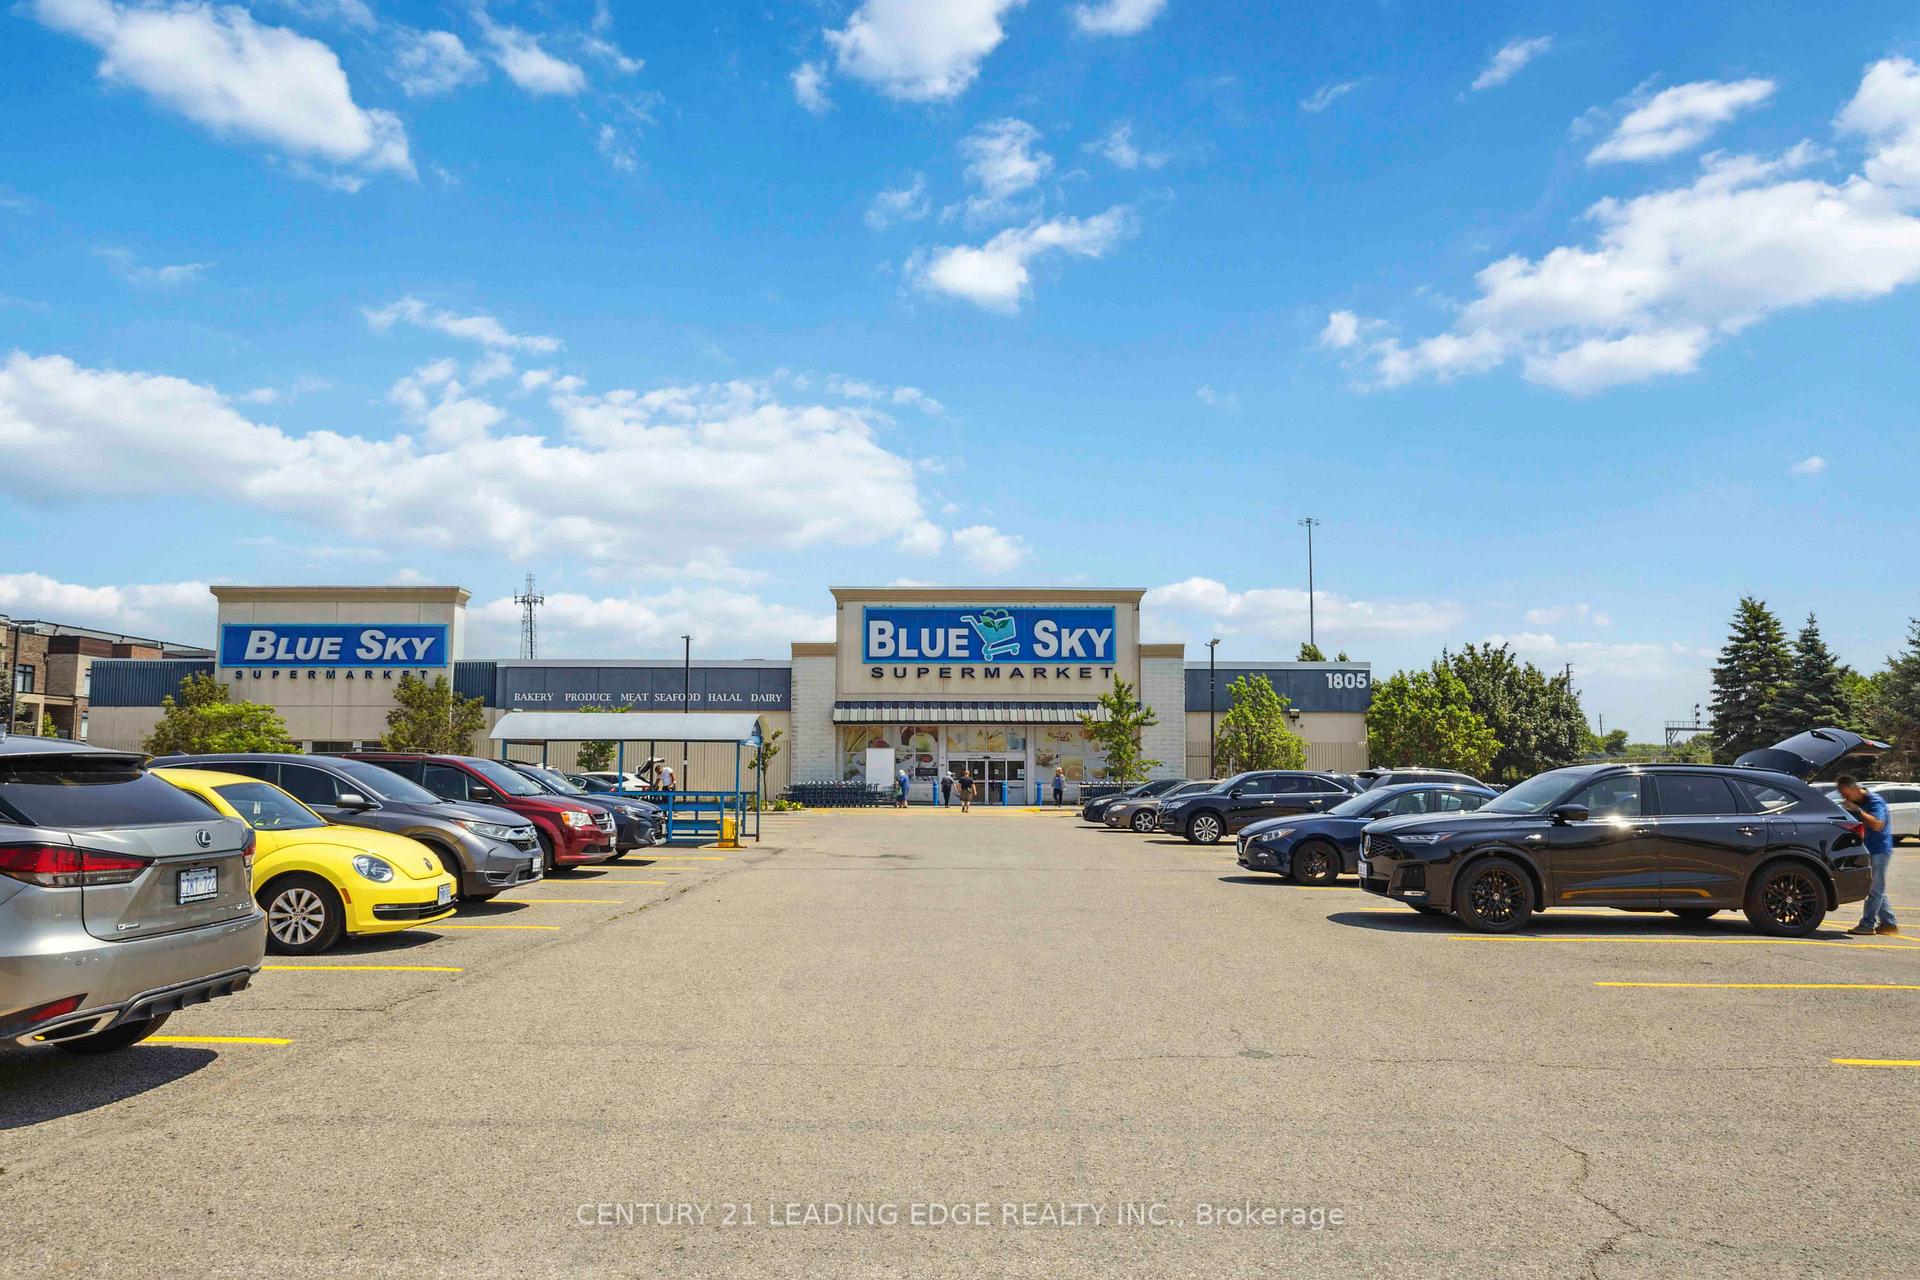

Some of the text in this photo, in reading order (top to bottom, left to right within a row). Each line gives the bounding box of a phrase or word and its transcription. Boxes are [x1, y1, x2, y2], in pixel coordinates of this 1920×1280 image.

[244, 629, 436, 661] BLUE SKY
[868, 619, 1113, 658] BLUE SKY
[235, 670, 427, 680] SUPERMARKET
[870, 667, 1113, 679] SUPERMARKET
[1326, 672, 1367, 689] 1805
[514, 692, 782, 702] BAKERY PRODUCE MEAT SEAFOOD HALAL DAIRY
